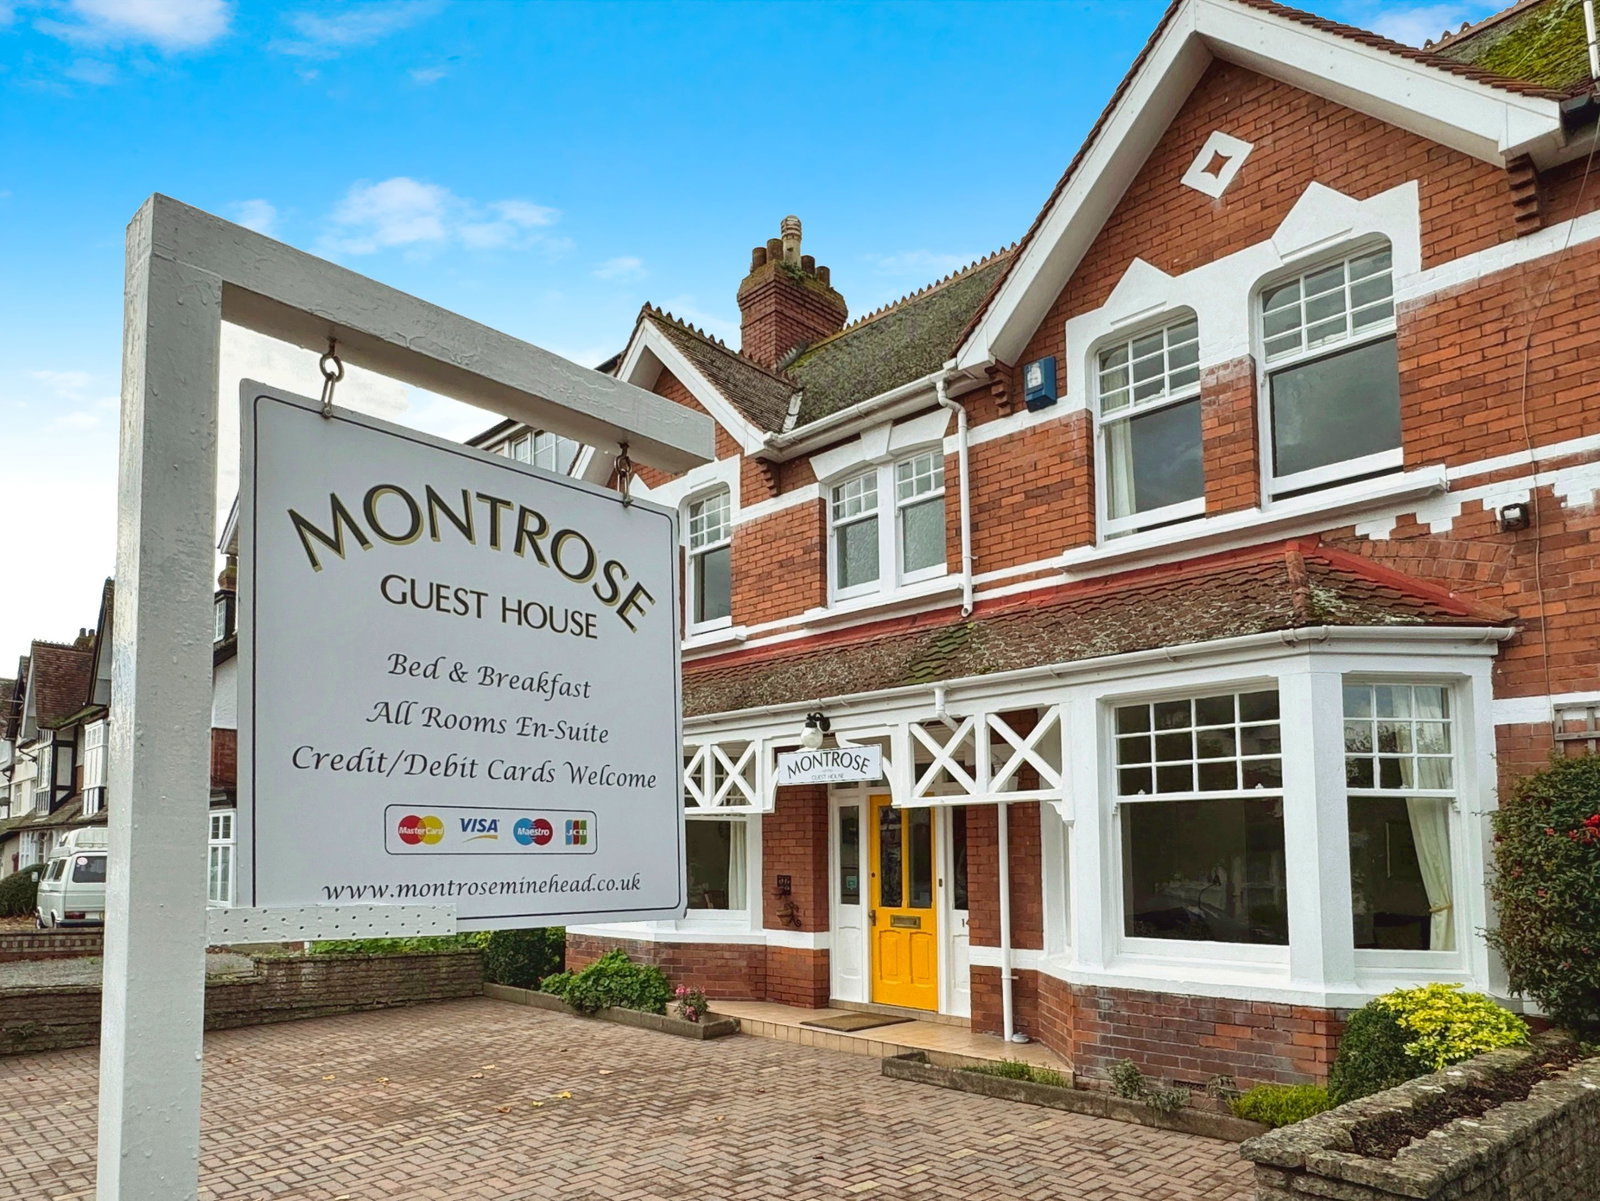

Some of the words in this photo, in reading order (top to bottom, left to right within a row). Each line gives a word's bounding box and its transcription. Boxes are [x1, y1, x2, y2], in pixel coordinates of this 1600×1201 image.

[287, 484, 656, 634] MONTROSE
[381, 574, 488, 619] GUEST
[502, 597, 597, 640] HOUSE
[387, 653, 446, 680] Bed
[448, 662, 469, 684] &
[478, 665, 592, 702] Breakfast
[366, 700, 418, 726] All
[421, 706, 507, 735] Rooms
[515, 716, 609, 744] En-Suite
[292, 745, 479, 781] Credit/Debit
[487, 759, 556, 785] Cards
[563, 761, 657, 790] Welcome
[786, 751, 871, 779] MONTROSE
[398, 825, 445, 836] MasterCard
[459, 817, 498, 833] VISA
[517, 826, 550, 837] Maestro
[565, 828, 587, 837] JCB
[322, 873, 640, 900] www.montroseminehead.co.uk
